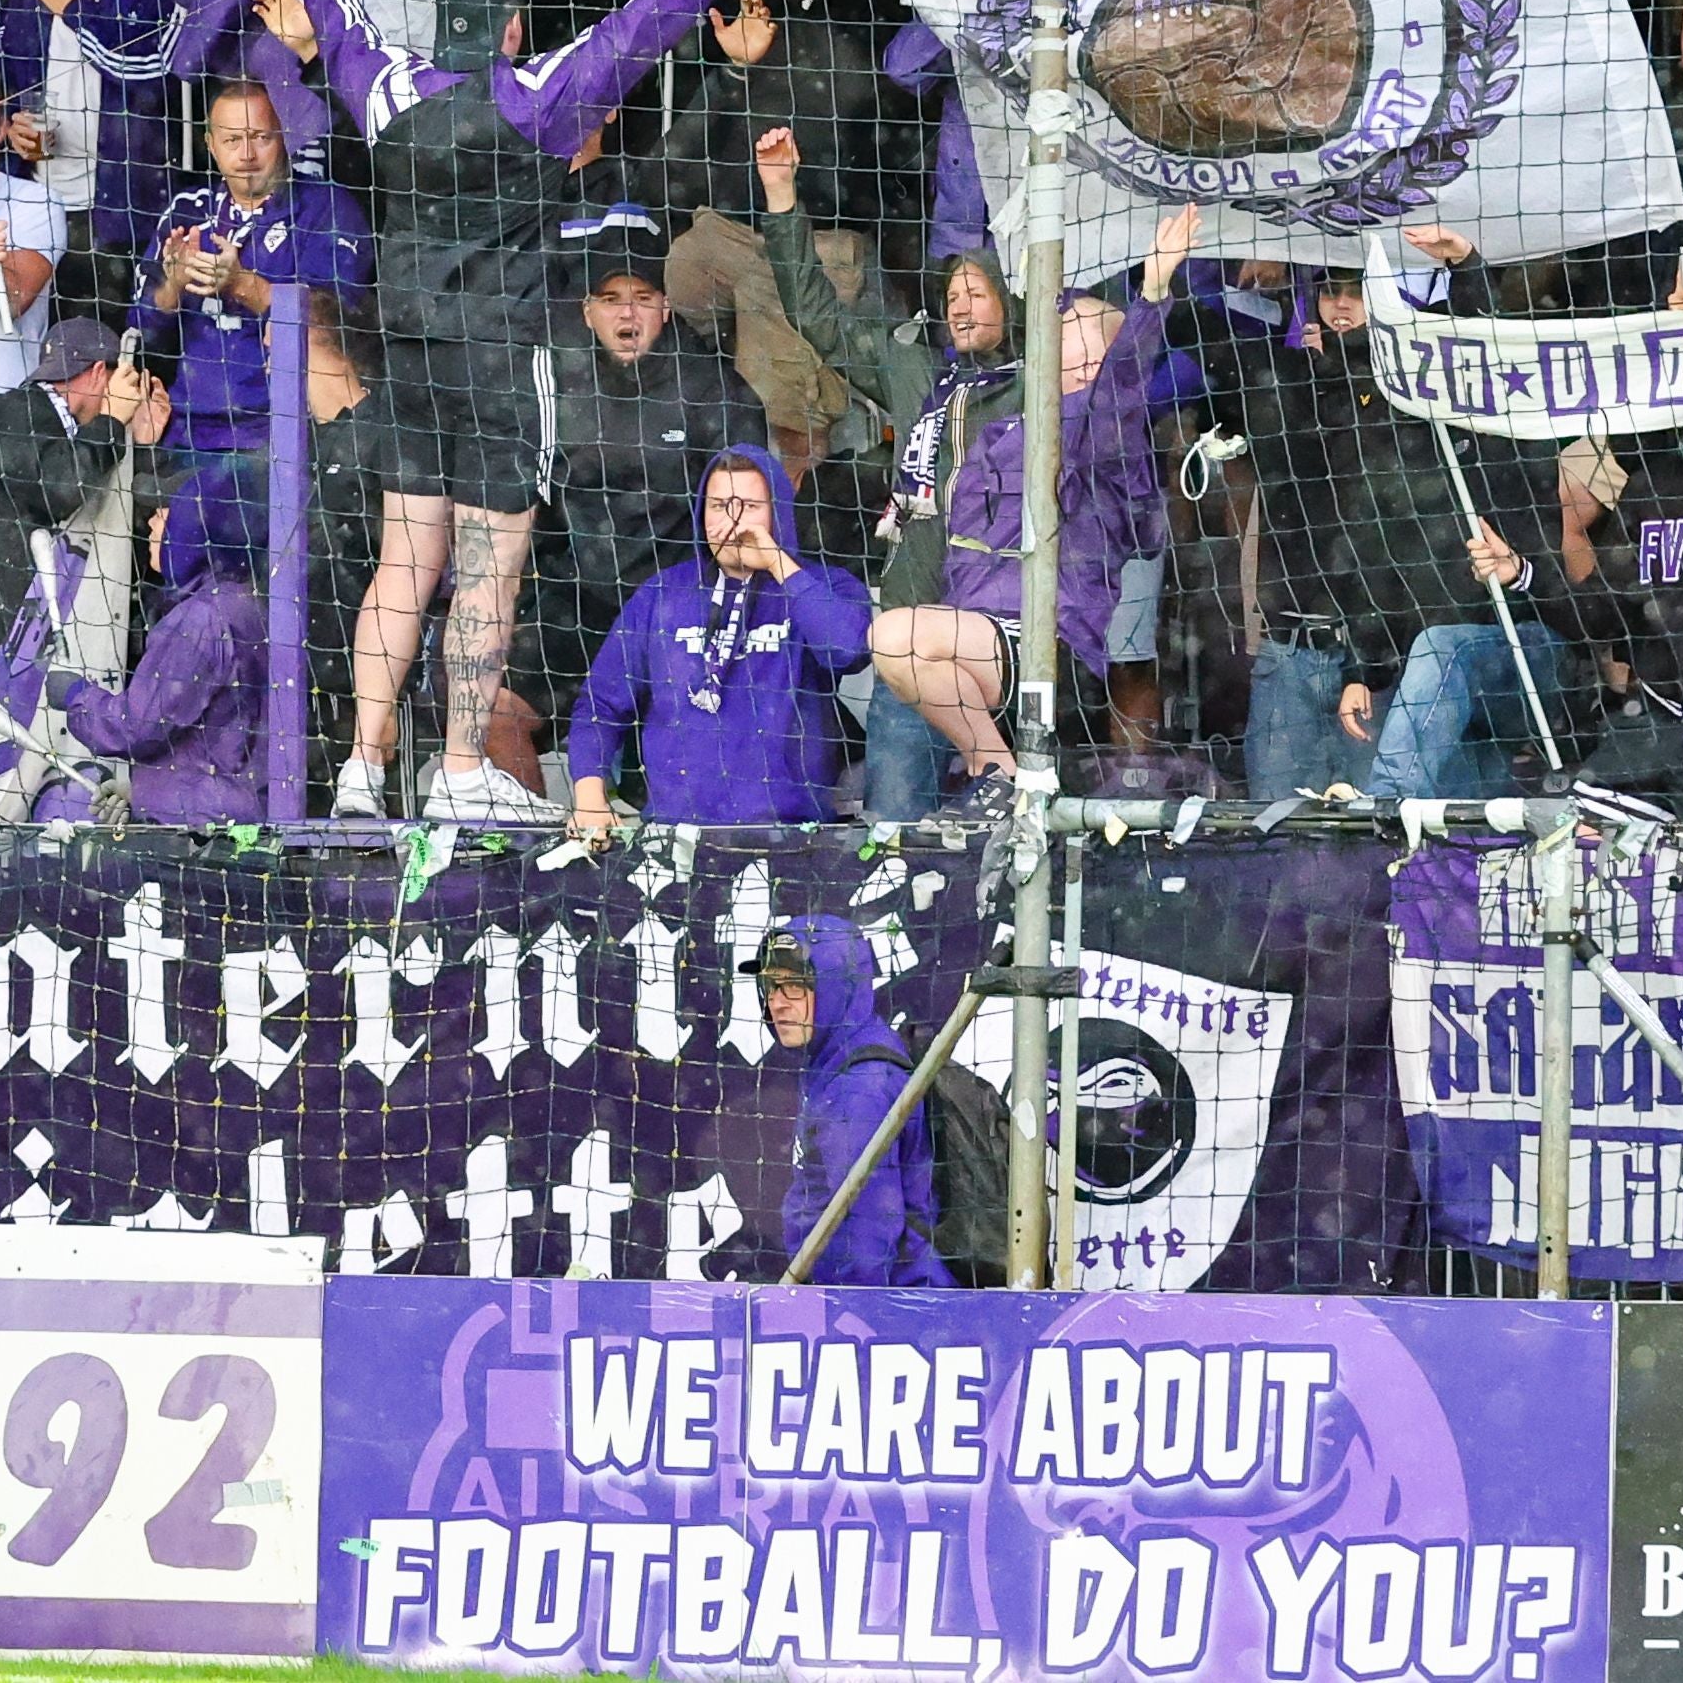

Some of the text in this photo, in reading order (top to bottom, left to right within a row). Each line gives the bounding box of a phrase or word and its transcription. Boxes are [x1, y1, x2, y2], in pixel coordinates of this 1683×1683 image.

[1080, 965, 1270, 1040] ternité
[1076, 1225, 1187, 1270] ette
[567, 1334, 1335, 1487] WE CARE ABOUT
[360, 1514, 1577, 1683] FOOTBALL, DO YOU?
